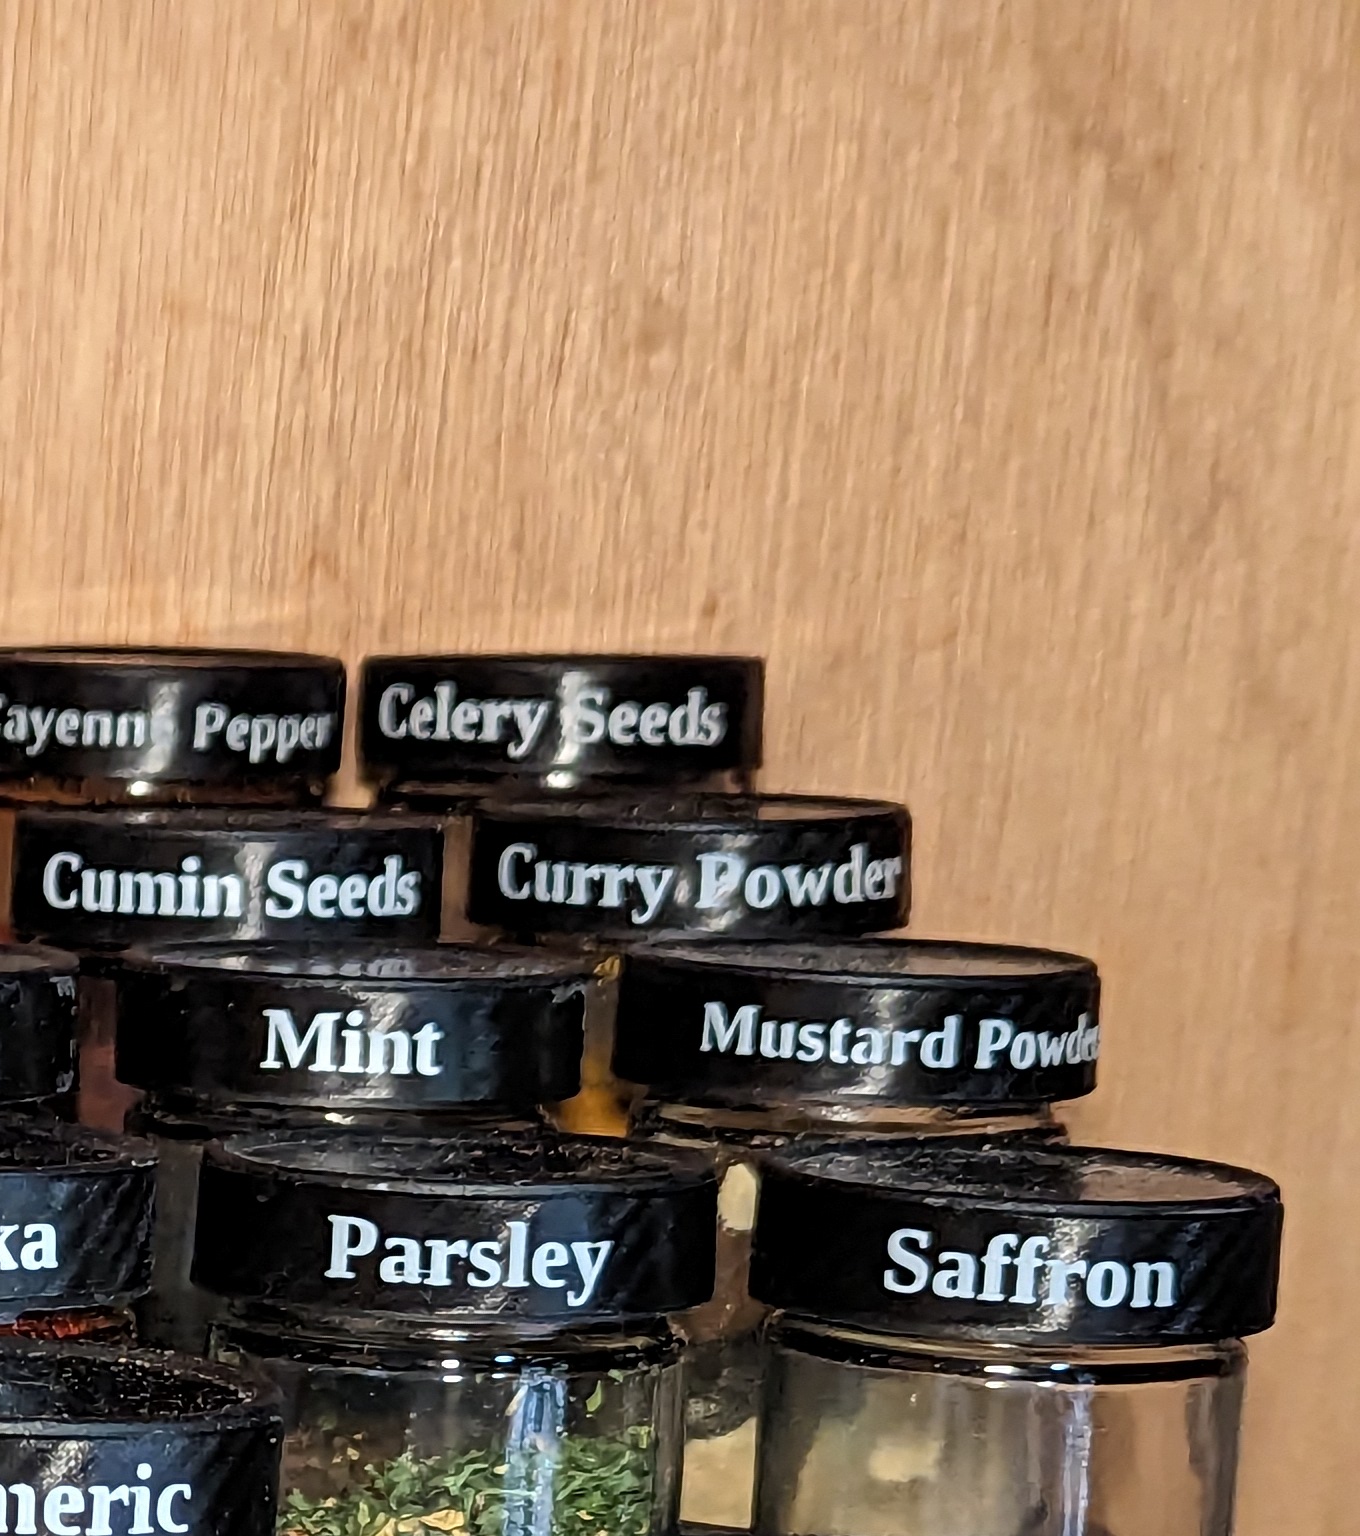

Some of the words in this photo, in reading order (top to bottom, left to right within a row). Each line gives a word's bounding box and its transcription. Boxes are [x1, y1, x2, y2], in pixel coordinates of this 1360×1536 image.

[193, 702, 333, 763] Pepper
[378, 684, 547, 759] Celery
[570, 686, 727, 746] Seeds
[43, 851, 243, 918] Cumin
[265, 858, 420, 919] Seeds
[497, 842, 673, 924] Curry
[694, 845, 901, 911] Powder
[260, 1009, 445, 1076] Mint
[700, 1003, 960, 1068] Mustard
[975, 1012, 1100, 1070] Powde
[325, 1214, 614, 1307] Parsley
[883, 1228, 1180, 1310] Saffron
